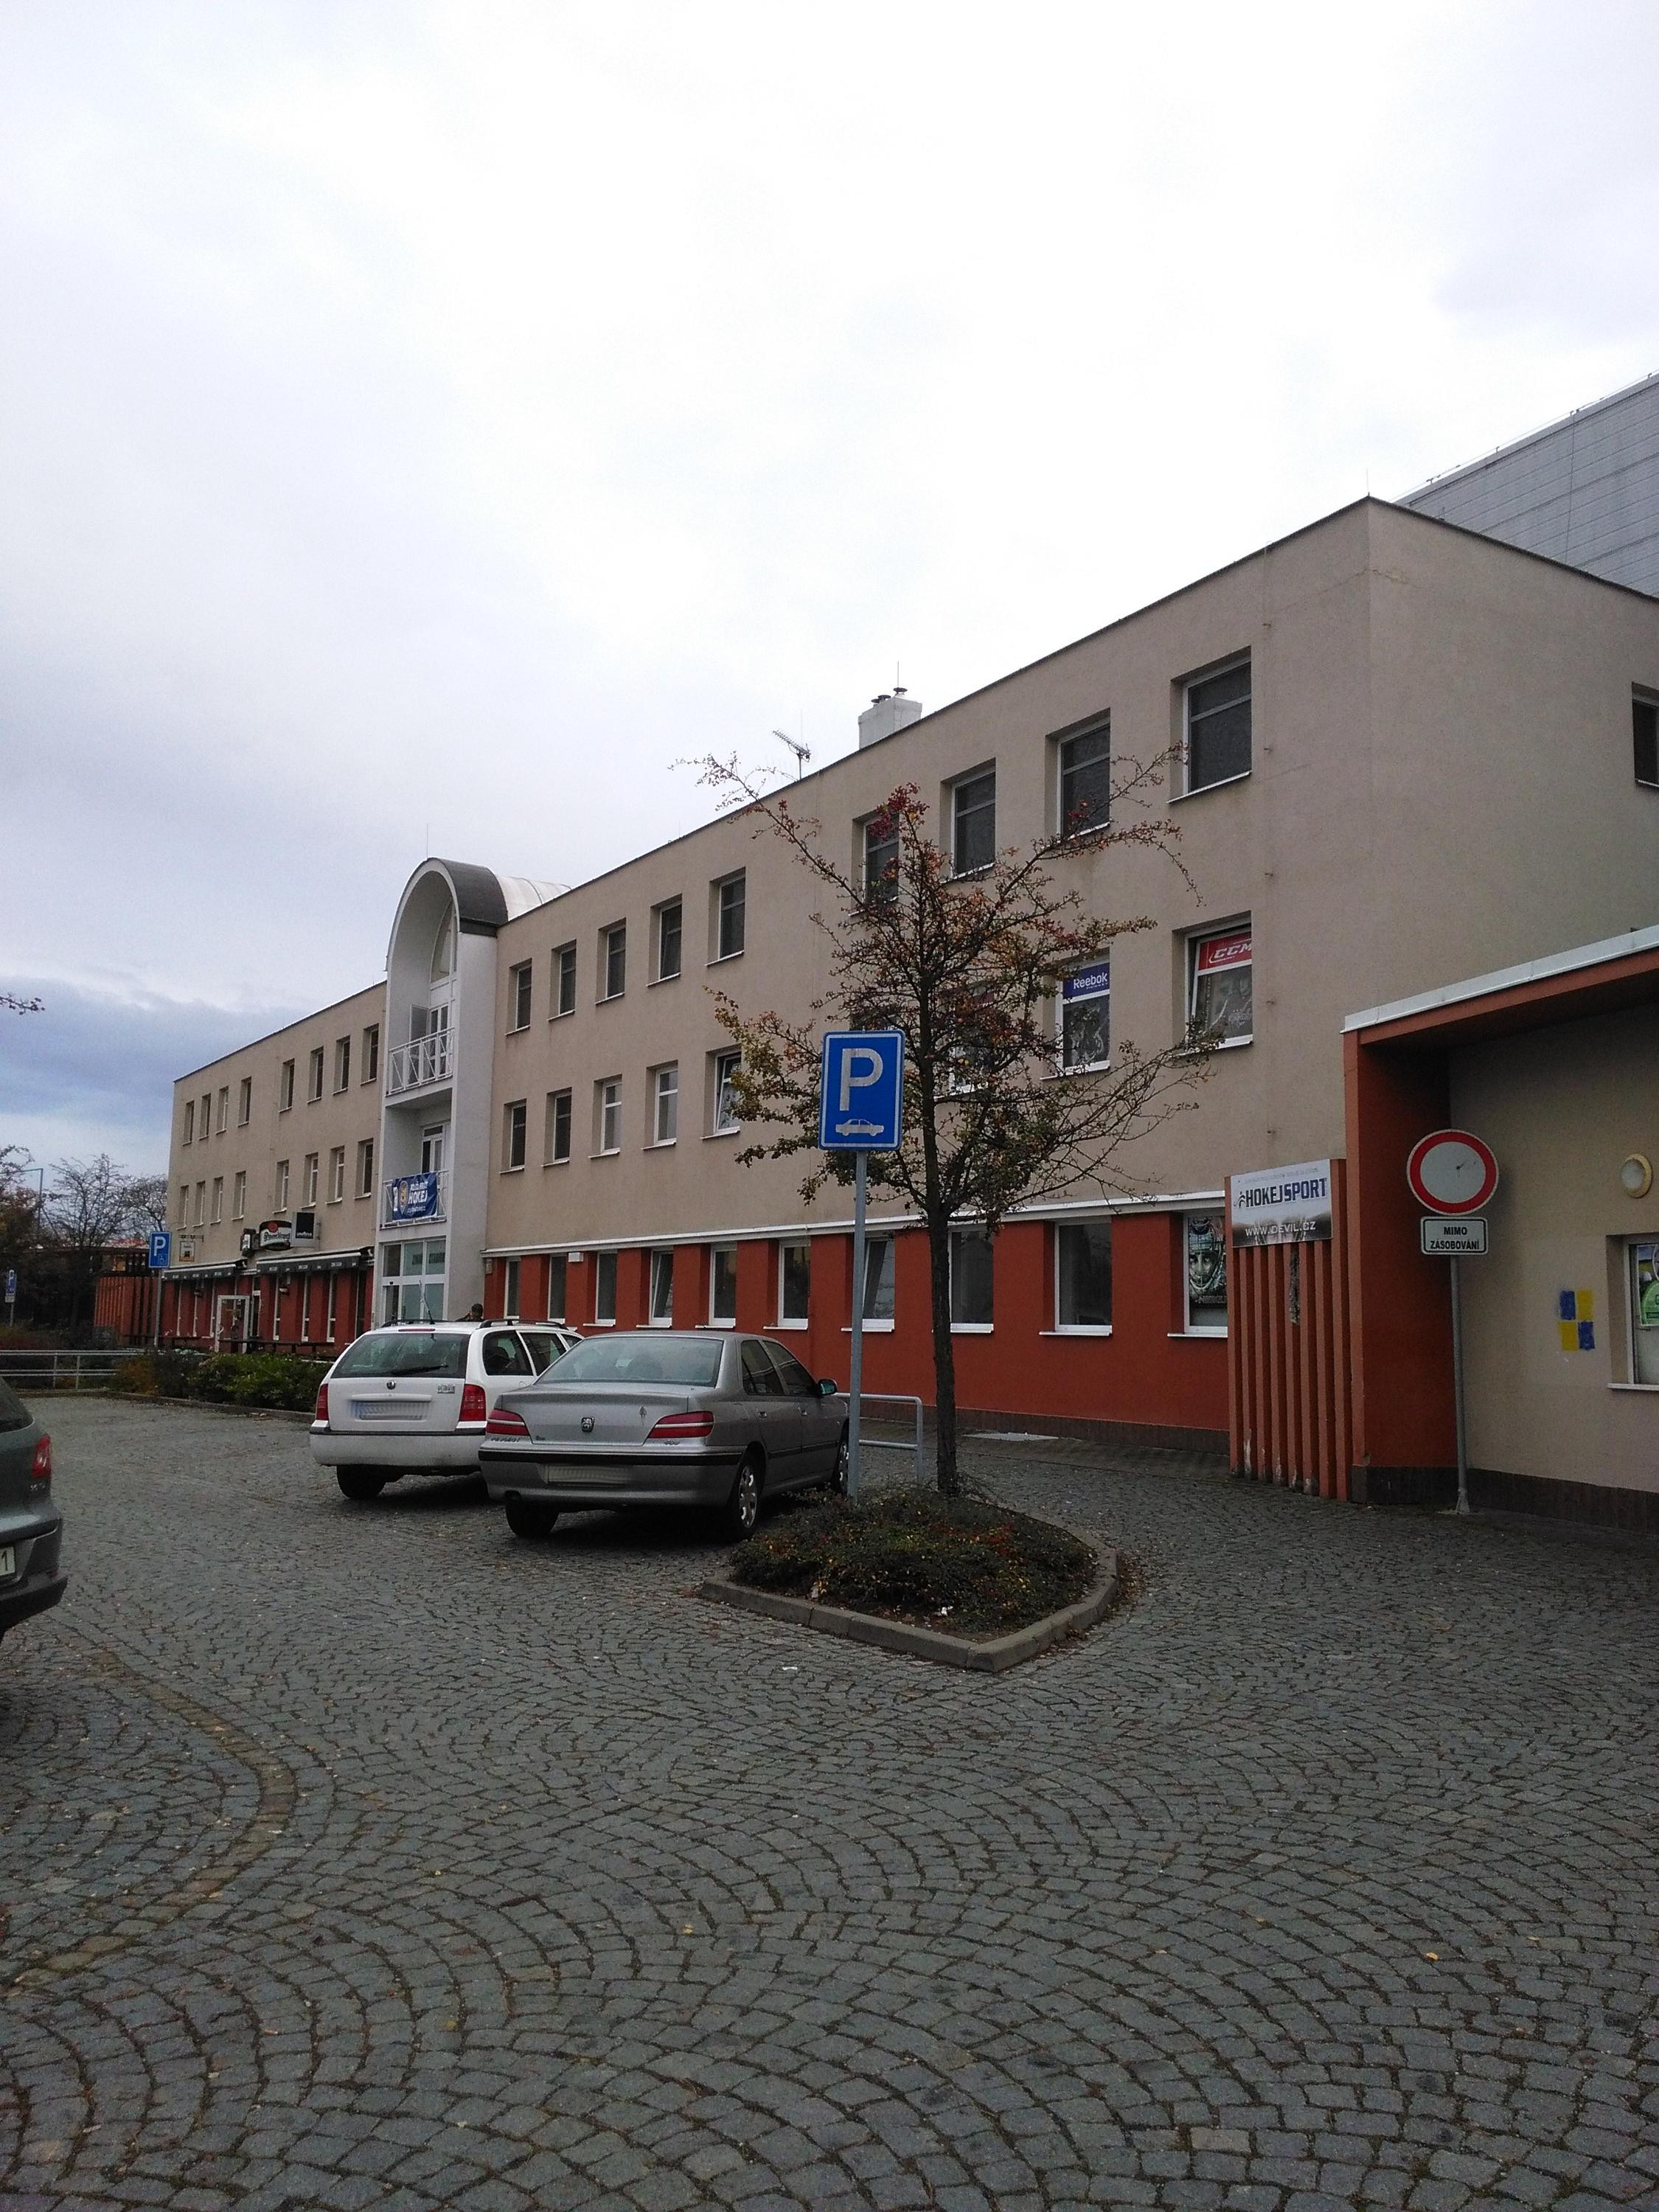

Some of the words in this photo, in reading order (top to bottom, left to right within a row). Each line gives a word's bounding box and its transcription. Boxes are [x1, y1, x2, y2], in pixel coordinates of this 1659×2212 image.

[1074, 972, 1107, 990] Reebok
[839, 1048, 884, 1111] P
[408, 1190, 428, 1204] HOKEJ
[1245, 1178, 1327, 1208] HOKEJSPORT
[1245, 1221, 1316, 1237] WWW.DEVIL.CZ
[1443, 1226, 1468, 1235] MIMO
[153, 1237, 167, 1256] P
[1430, 1239, 1480, 1250] ZÁSOBOVÁNÍ
